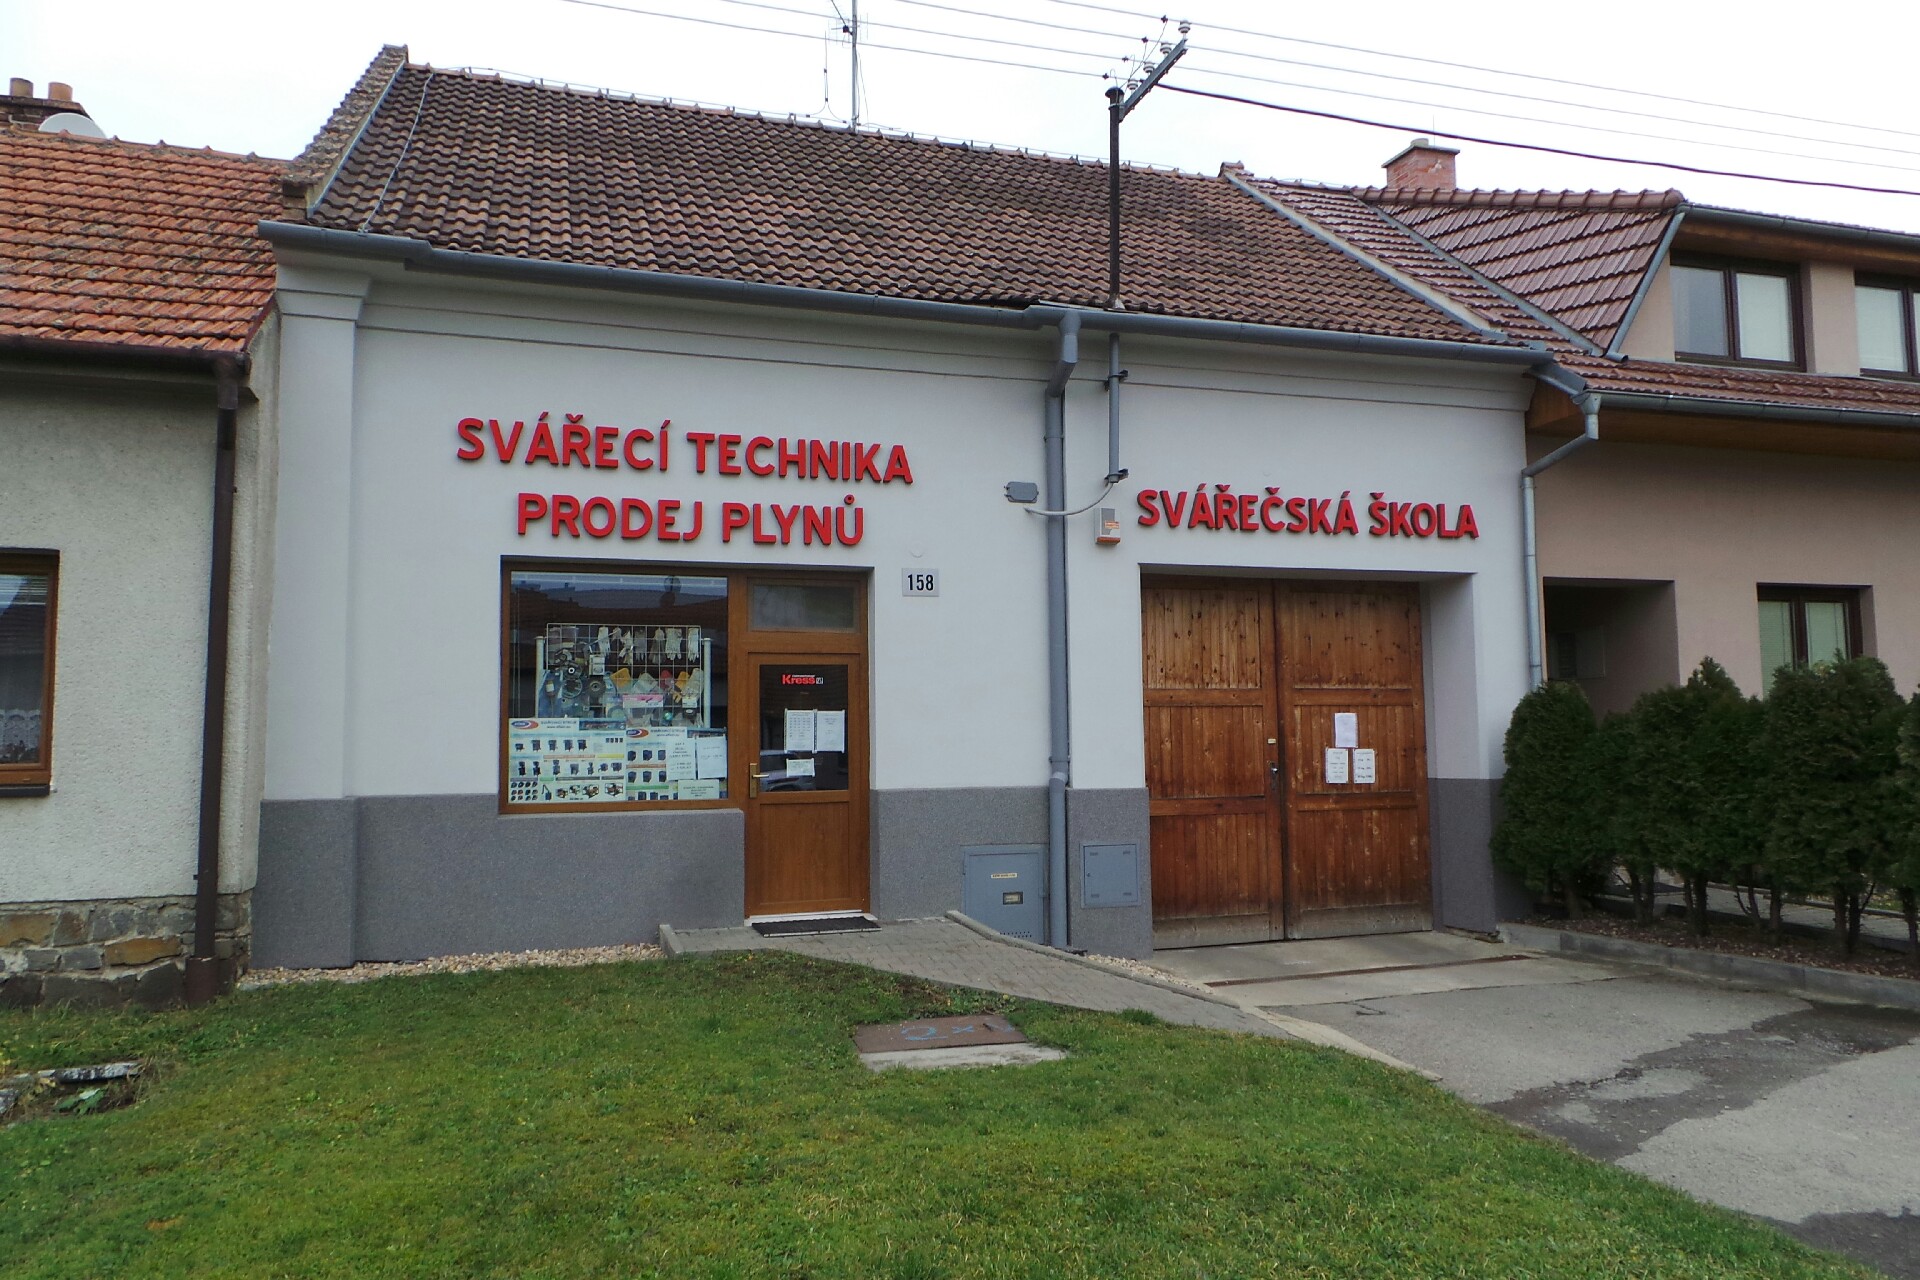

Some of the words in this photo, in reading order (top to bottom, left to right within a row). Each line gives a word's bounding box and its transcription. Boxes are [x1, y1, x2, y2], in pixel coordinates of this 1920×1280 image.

[456, 411, 671, 472] SVÁŘECÍ
[686, 431, 914, 485] TECHNIKA
[516, 492, 704, 542] PRODEJ
[721, 494, 866, 546] PLYNŮ
[1137, 483, 1360, 535] SVÁŘEČSKÁ
[1368, 492, 1480, 539] ŠKOLA
[907, 574, 934, 592] 158
[781, 673, 816, 685] Kress
